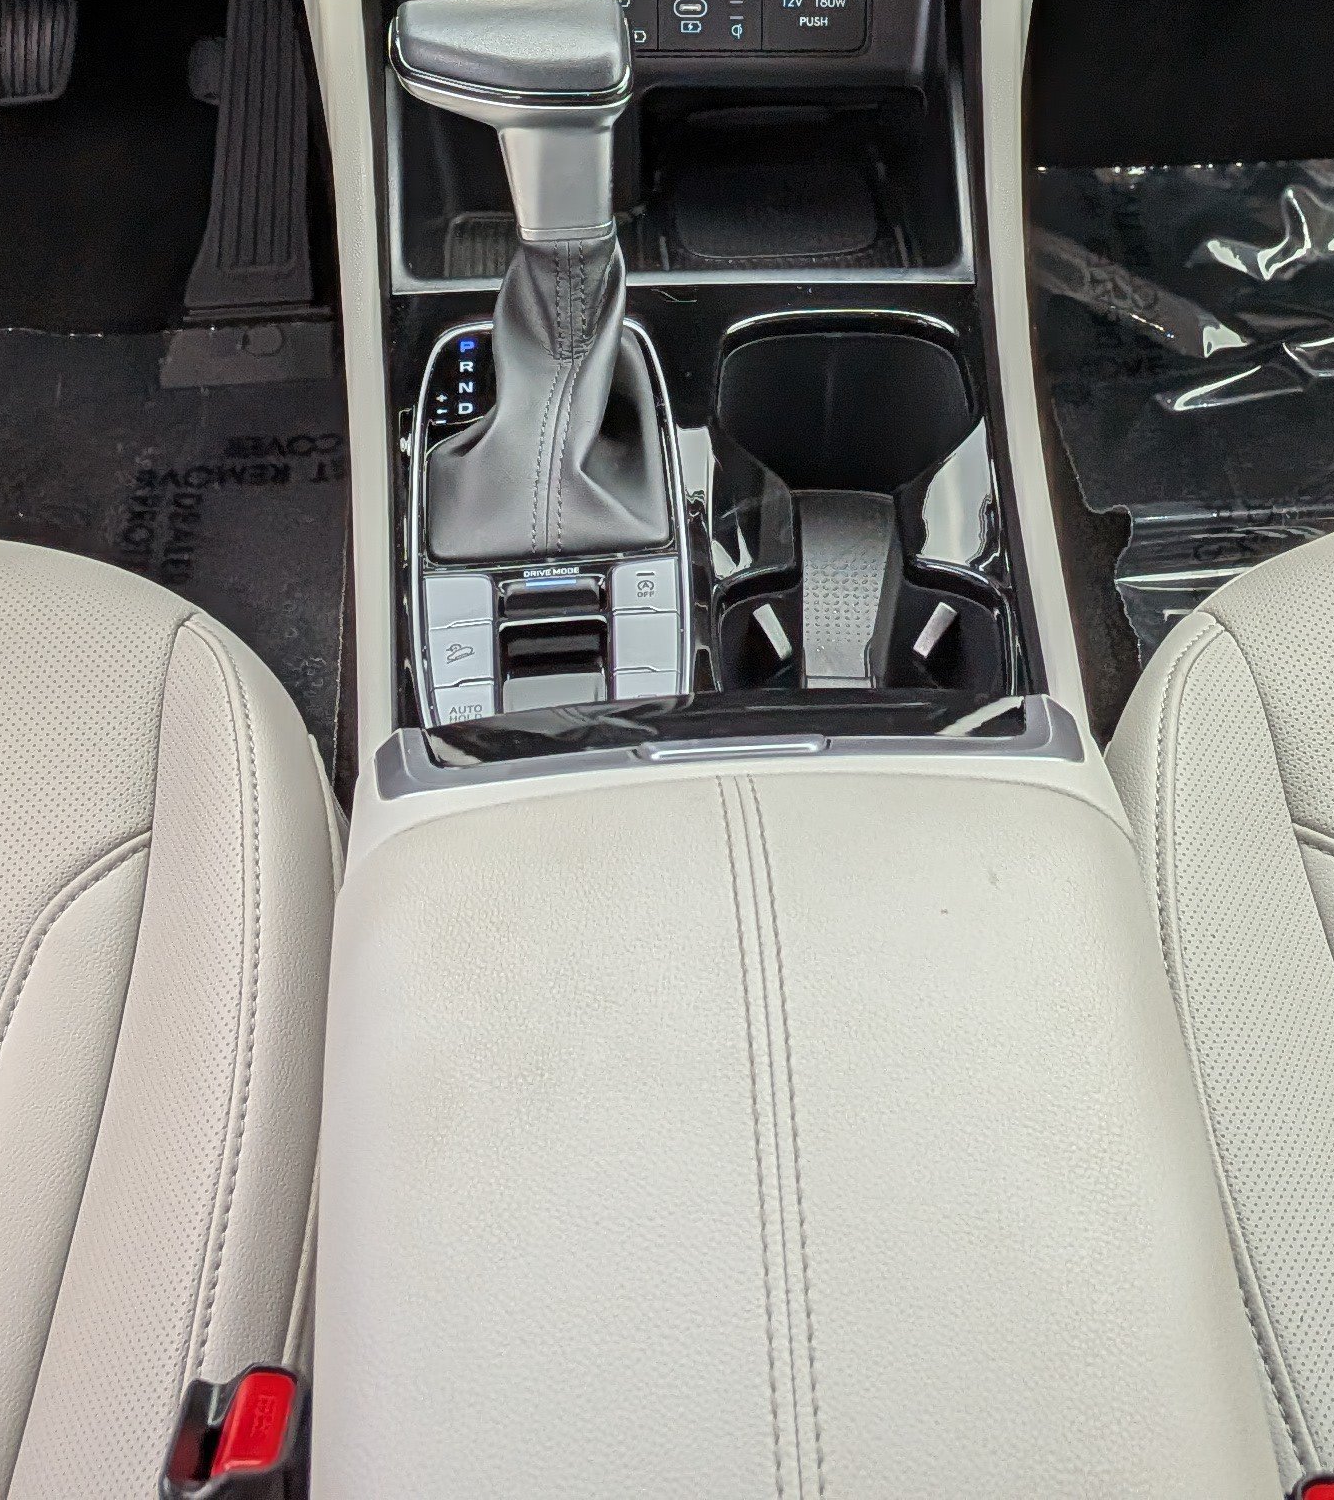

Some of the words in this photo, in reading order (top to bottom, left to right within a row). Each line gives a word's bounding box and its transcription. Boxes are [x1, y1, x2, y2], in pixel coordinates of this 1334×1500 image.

[799, 16, 829, 27] PUSH
[459, 340, 475, 353] P
[459, 361, 474, 373] R
[458, 381, 474, 394] N
[458, 402, 474, 415] D
[523, 567, 552, 578] DRIVE
[552, 566, 580, 576] MODE
[449, 704, 483, 714] AUTO
